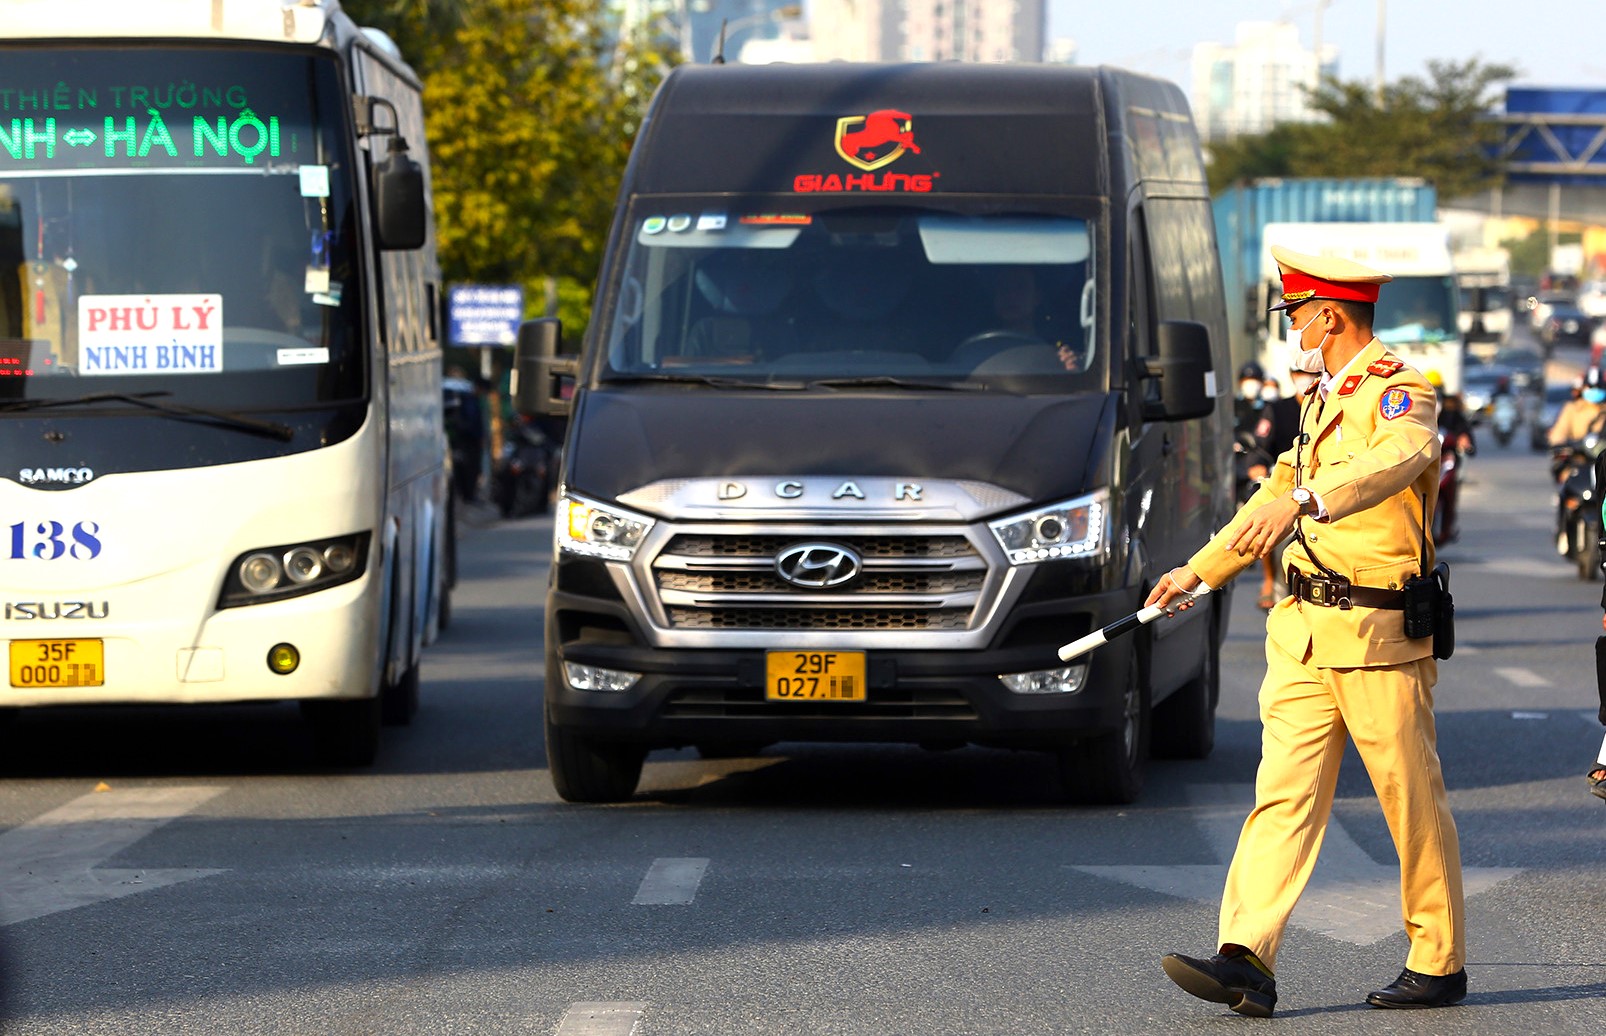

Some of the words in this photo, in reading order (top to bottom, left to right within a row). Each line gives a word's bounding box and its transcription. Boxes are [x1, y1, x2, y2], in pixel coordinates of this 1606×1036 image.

[0, 81, 97, 111] THIÊN
[109, 80, 248, 109] TRƯỜNG
[104, 107, 178, 157] HÀ
[193, 107, 280, 164] NỘI
[87, 298, 158, 331] PHỦ
[172, 298, 215, 330] LÝ
[86, 345, 147, 369] NINH
[156, 338, 215, 368] BÌNH
[19, 467, 94, 484] SAMCO
[8, 520, 102, 560] 138
[5, 601, 109, 620] ISUZU
[38, 643, 76, 661] 35F
[21, 664, 96, 686] 000.
[795, 654, 837, 674] 29F
[777, 676, 854, 698] 027.
